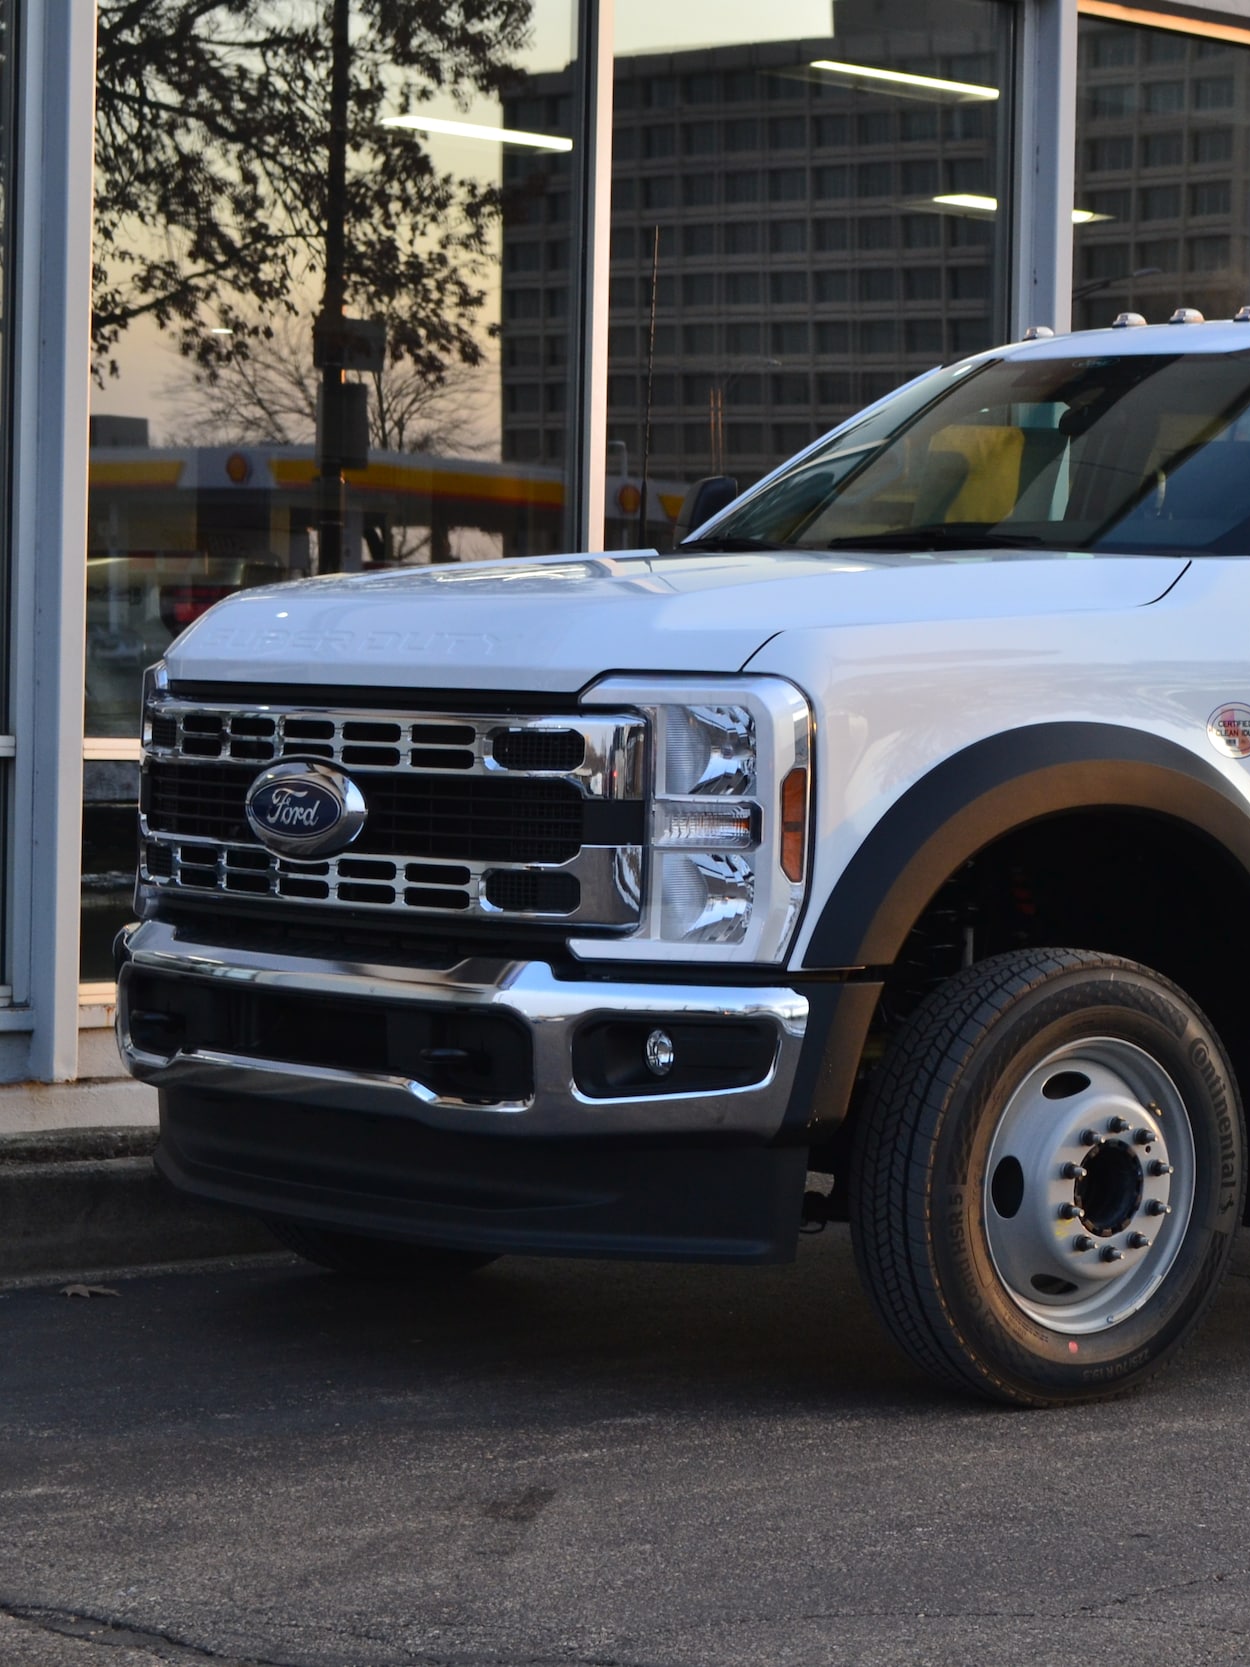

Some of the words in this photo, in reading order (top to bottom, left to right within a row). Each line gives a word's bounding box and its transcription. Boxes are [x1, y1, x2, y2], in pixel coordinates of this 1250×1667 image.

[200, 627, 354, 654] SUPER
[358, 629, 502, 657] DUTY
[1215, 729, 1239, 737] CLEAN
[266, 787, 321, 826] Ford
[1188, 1037, 1236, 1188] Continental
[948, 1192, 964, 1208] 5
[948, 1211, 968, 1257] HSR
